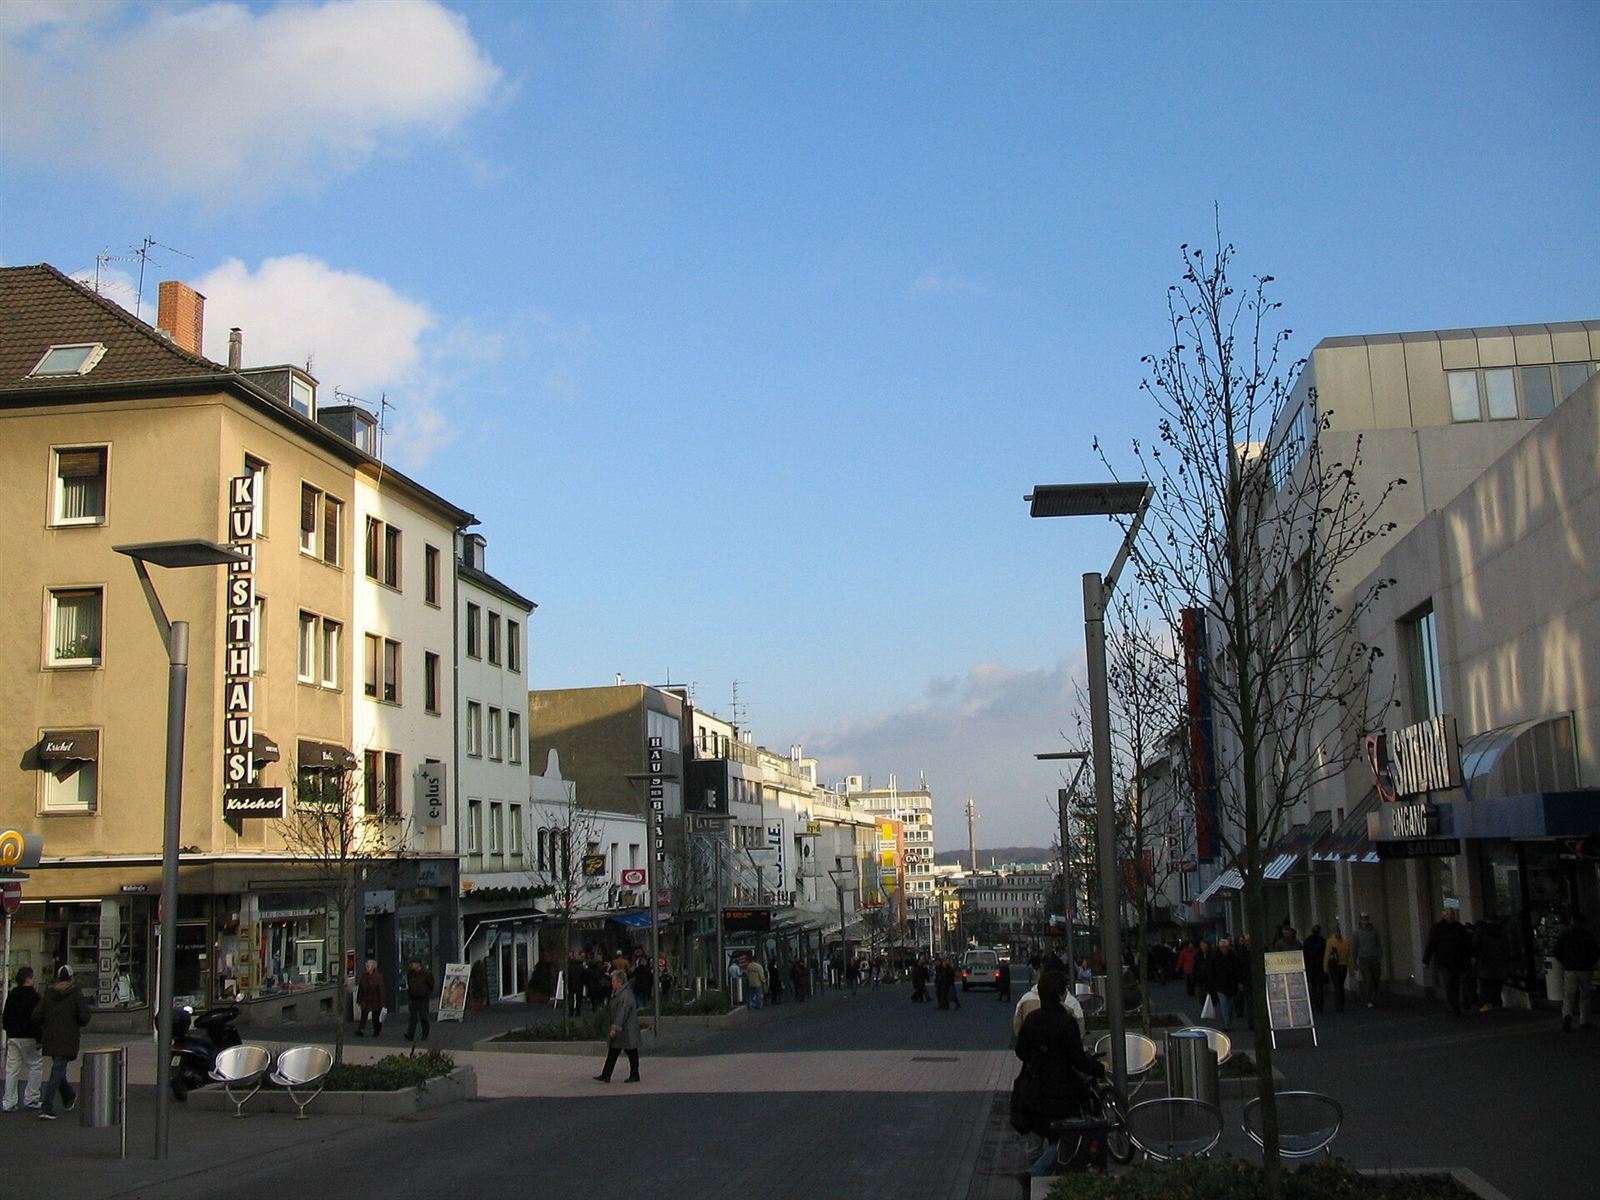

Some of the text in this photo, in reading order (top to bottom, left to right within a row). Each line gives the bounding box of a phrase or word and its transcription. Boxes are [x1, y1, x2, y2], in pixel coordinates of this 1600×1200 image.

[229, 478, 253, 780] KUNSTHAUS
[45, 741, 73, 753] Krichel
[651, 738, 661, 785] HAUS
[1392, 714, 1450, 797] SATURN
[226, 797, 283, 811] Krichel
[1392, 803, 1428, 837] EINGANG
[1407, 841, 1457, 856] SATURN
